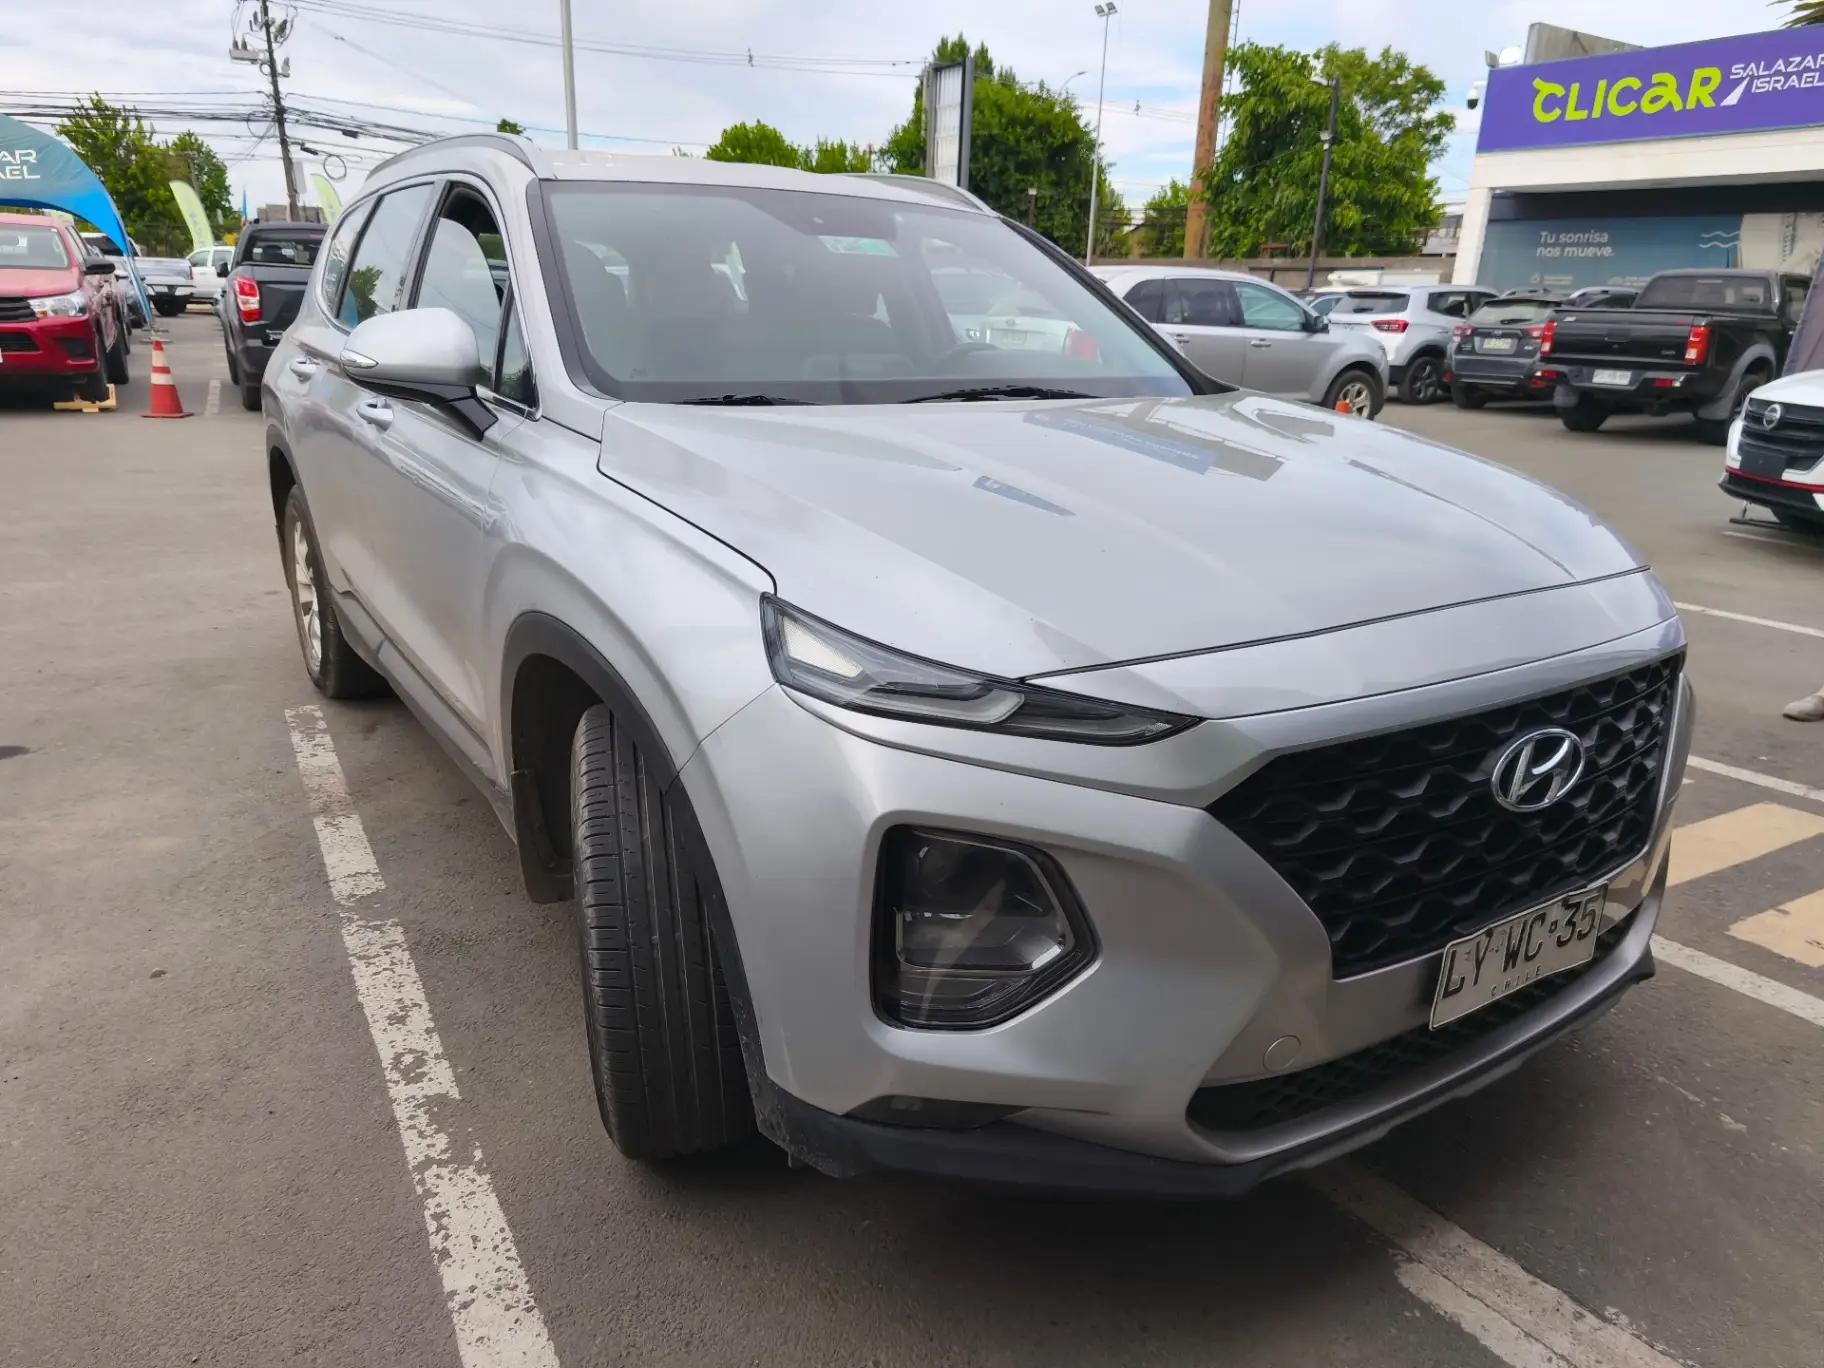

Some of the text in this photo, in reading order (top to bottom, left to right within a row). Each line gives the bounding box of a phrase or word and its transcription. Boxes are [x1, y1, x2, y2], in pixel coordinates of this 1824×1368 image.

[1751, 72, 1824, 93] ISRAEL
[1539, 229, 1609, 244] Tu sonrisa
[1536, 245, 1560, 257] nos
